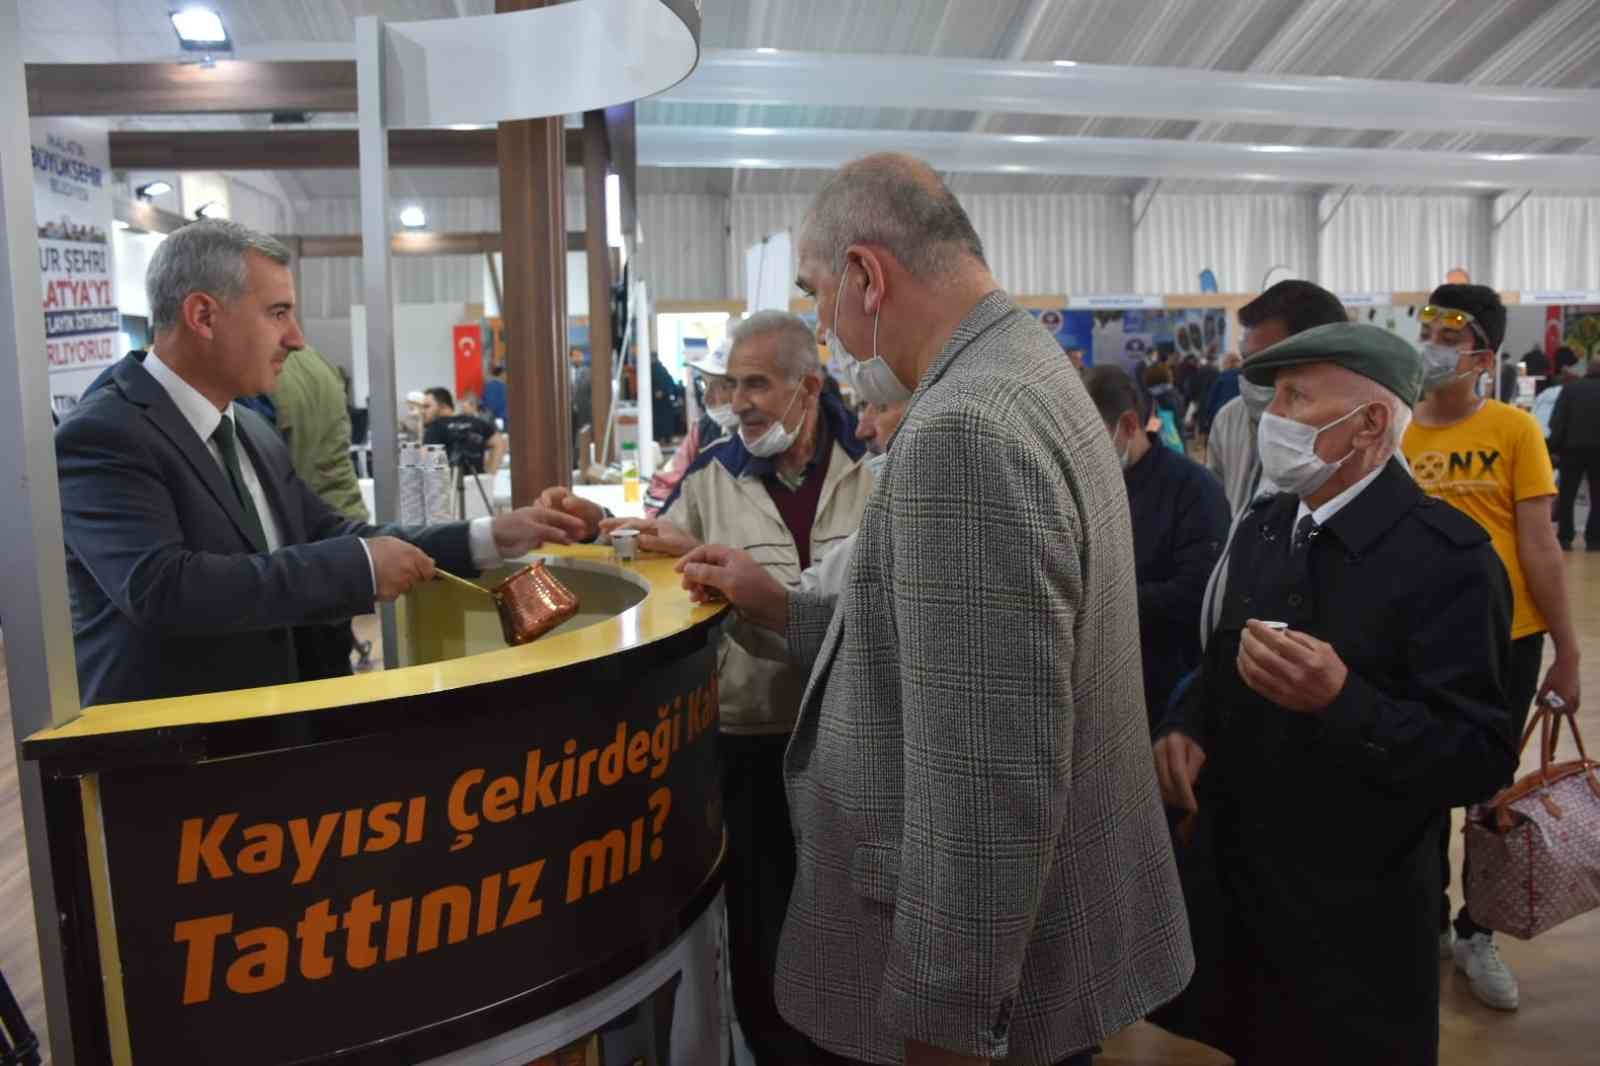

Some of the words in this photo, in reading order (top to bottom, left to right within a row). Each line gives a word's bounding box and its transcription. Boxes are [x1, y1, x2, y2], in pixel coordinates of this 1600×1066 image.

[176, 797, 427, 885] Kayısı
[447, 694, 683, 852] Çekirdeği
[174, 859, 547, 1004] Tattınız
[566, 788, 672, 904] mı?
